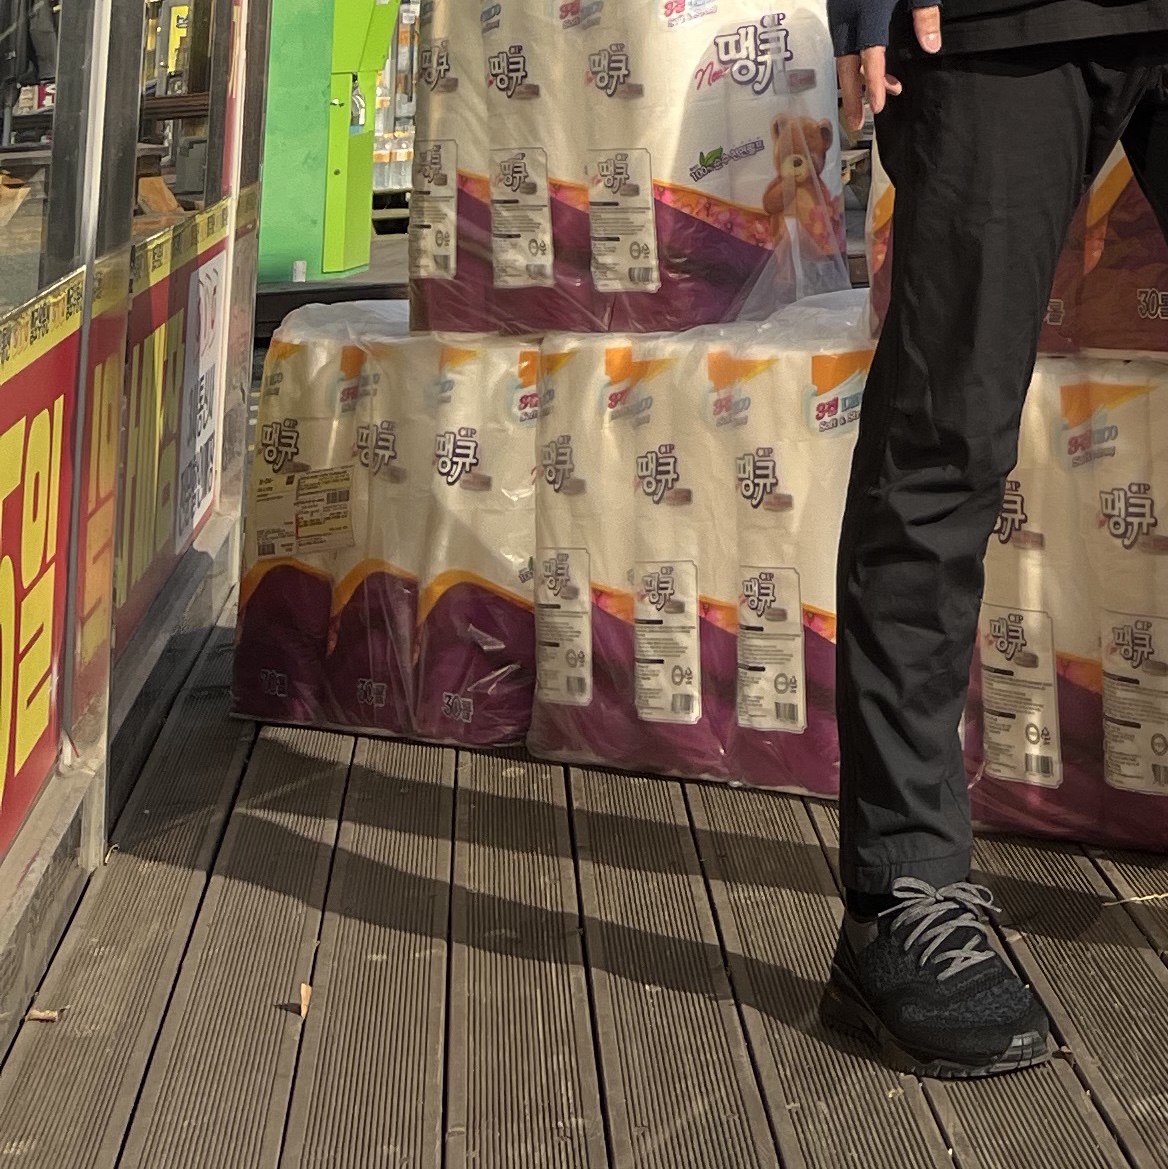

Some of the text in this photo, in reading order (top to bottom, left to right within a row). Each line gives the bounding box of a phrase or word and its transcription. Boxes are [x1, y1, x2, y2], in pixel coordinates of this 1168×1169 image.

[759, 12, 786, 27] CIP
[714, 23, 793, 95] 땡큐
[1099, 486, 1158, 550] 땡큐
